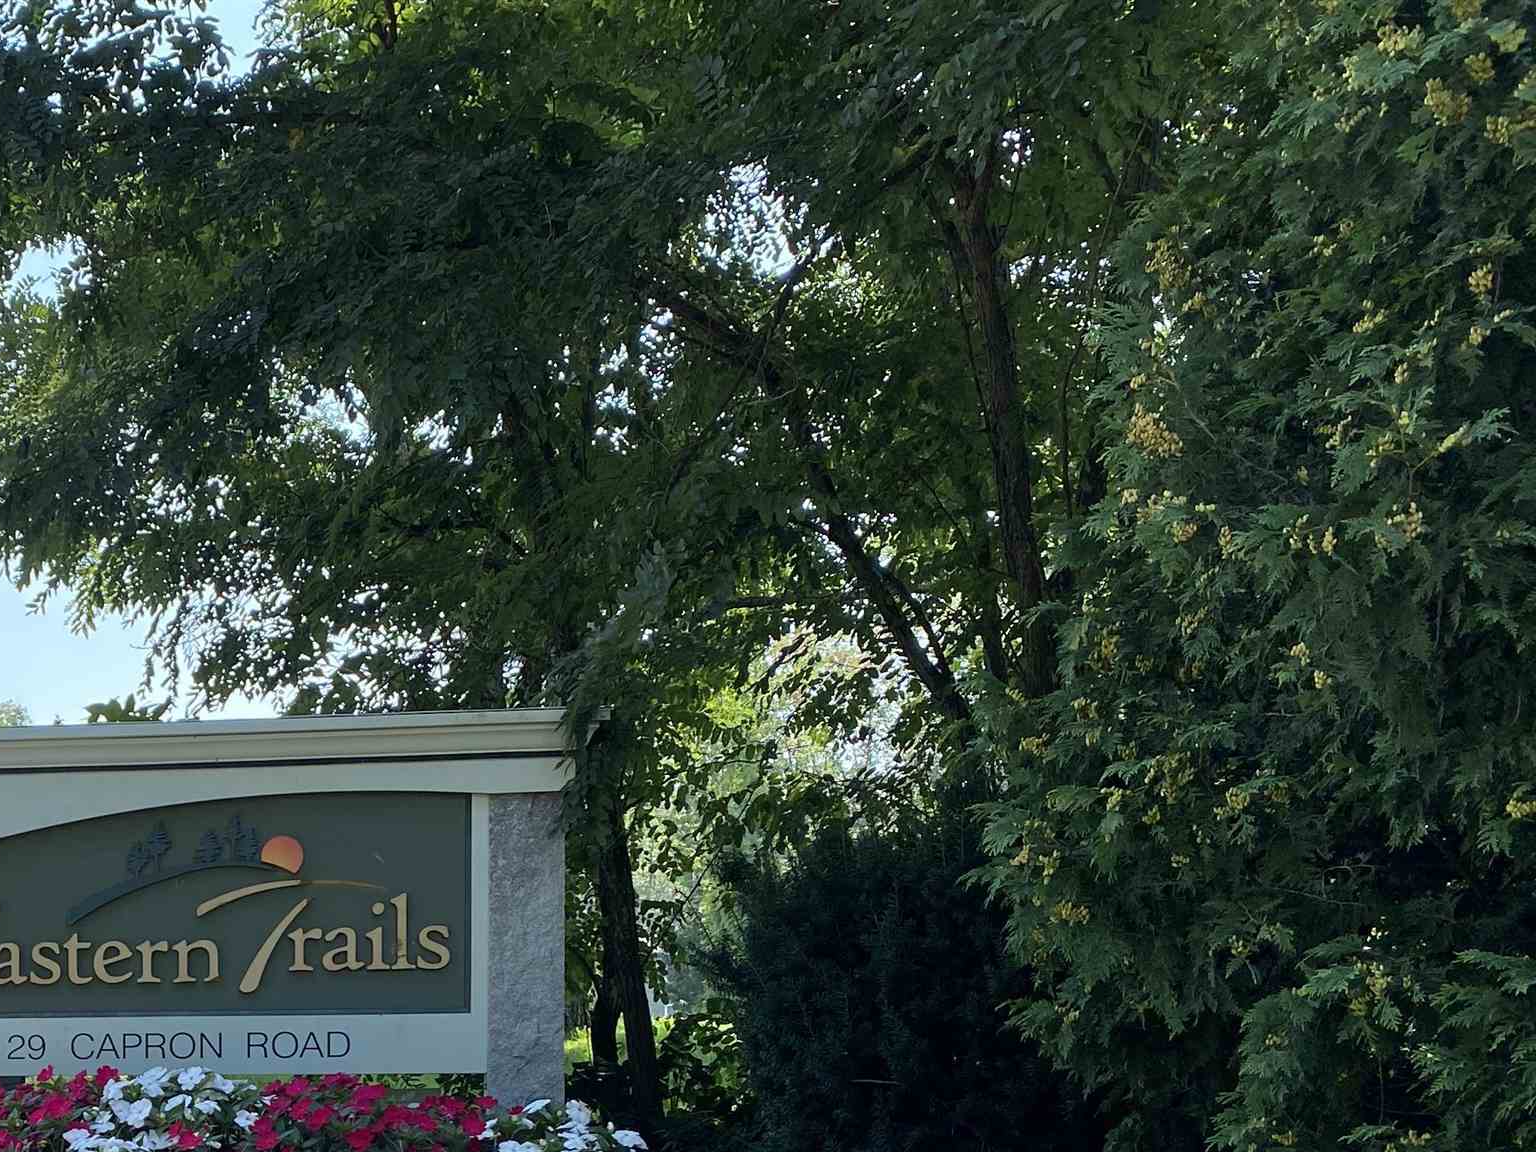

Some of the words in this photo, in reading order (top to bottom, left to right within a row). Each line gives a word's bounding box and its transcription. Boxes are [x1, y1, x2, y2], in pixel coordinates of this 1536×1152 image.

[196, 879, 451, 994] Trails
[6, 1033, 47, 1061] 29
[70, 1031, 224, 1061] CAPRON
[246, 1030, 352, 1060] ROAD
